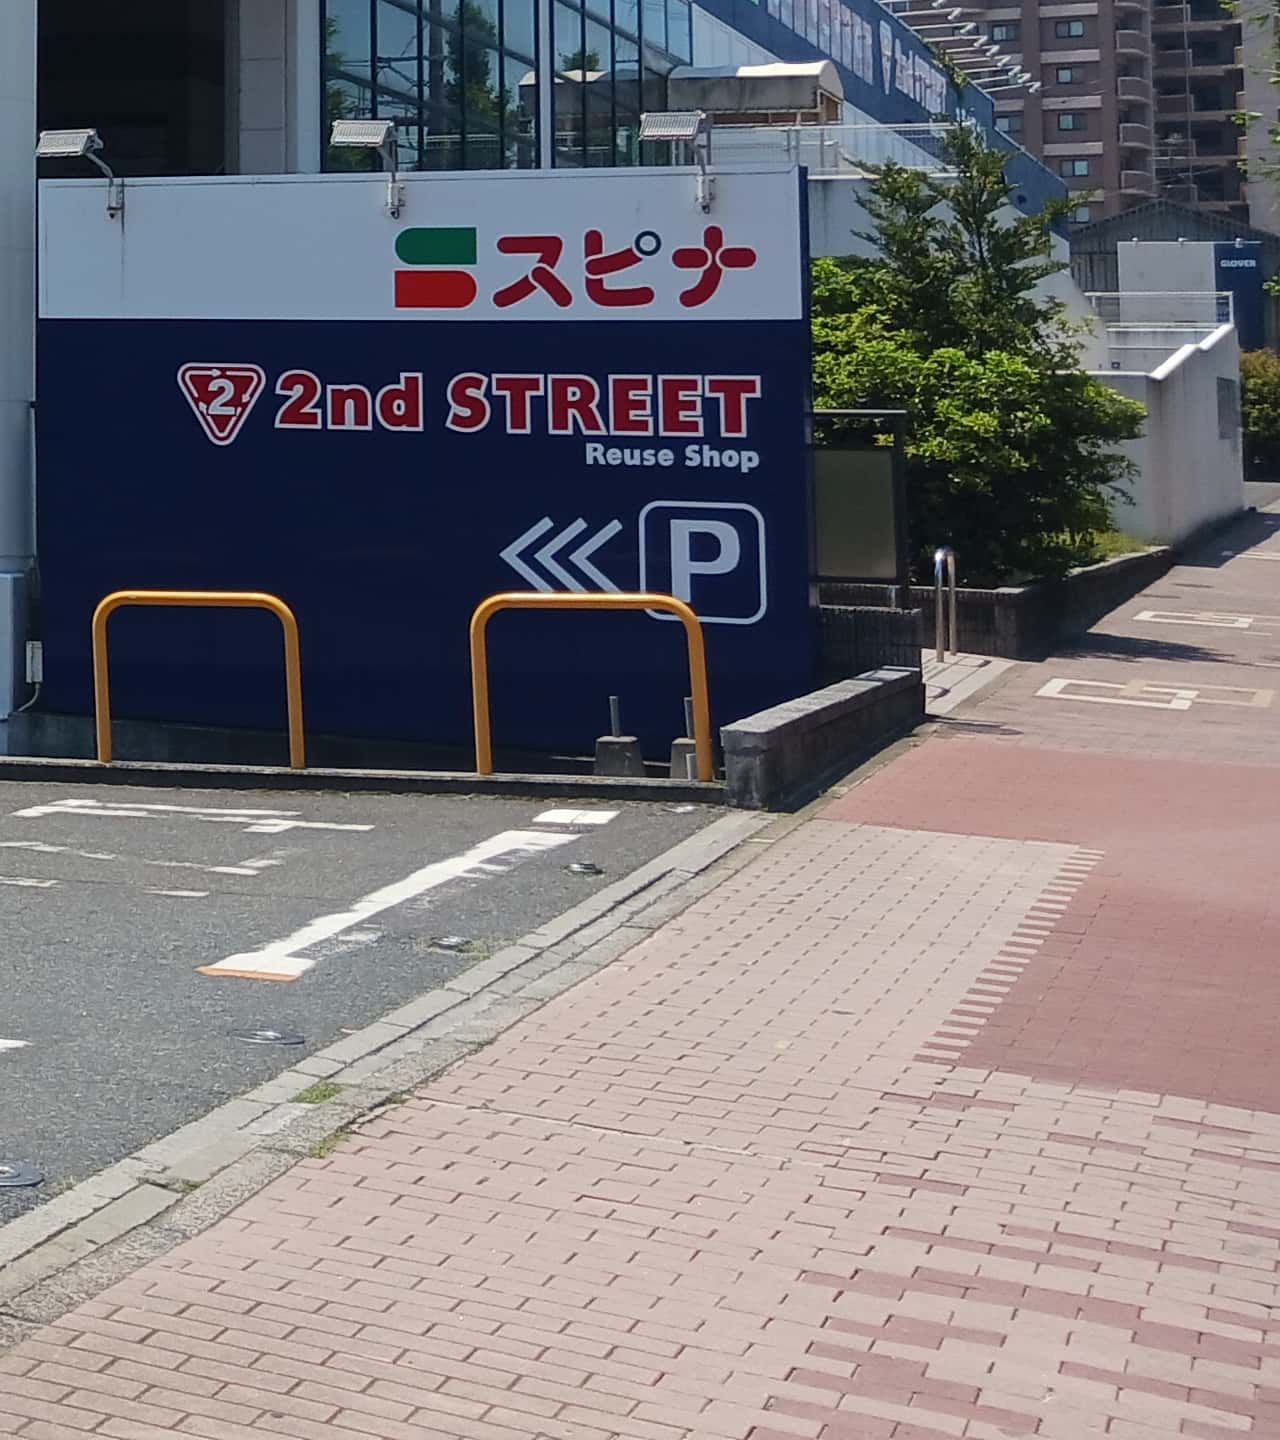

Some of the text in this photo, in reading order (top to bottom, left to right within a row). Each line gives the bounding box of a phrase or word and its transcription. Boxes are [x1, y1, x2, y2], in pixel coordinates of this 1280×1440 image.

[492, 225, 757, 309] スピナ
[273, 369, 425, 433] 2nd
[445, 372, 762, 438] STREET
[585, 442, 760, 473] Reuse Shop
[669, 518, 741, 603] P
